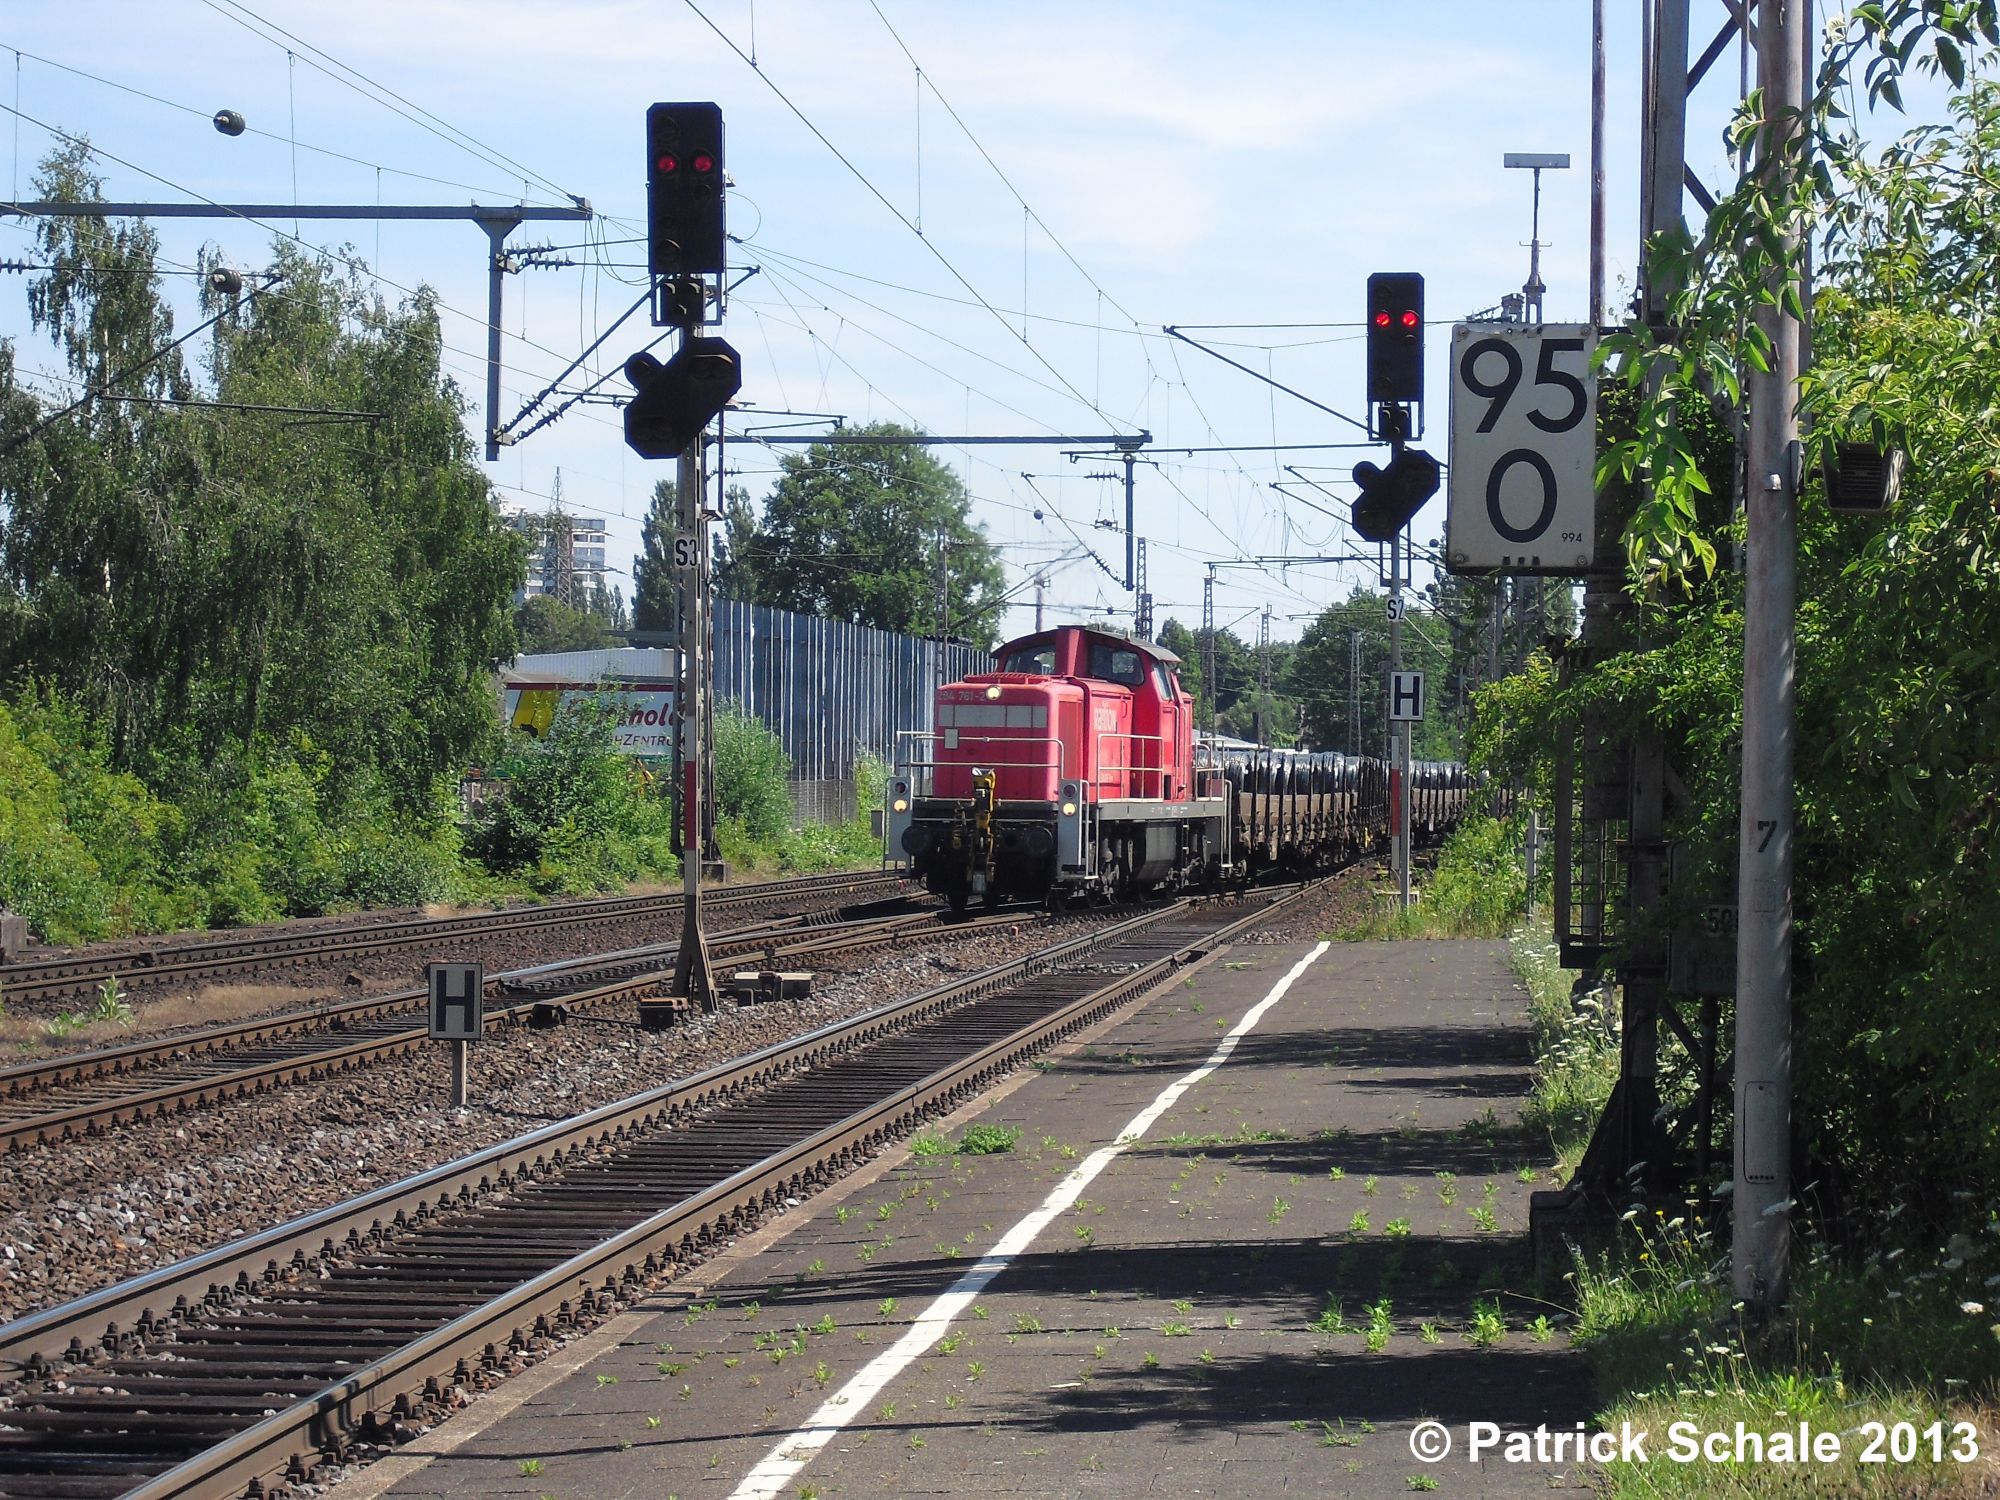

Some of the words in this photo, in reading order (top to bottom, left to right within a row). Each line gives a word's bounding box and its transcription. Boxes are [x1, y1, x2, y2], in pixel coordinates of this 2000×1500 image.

[1460, 338, 1588, 434] 95
[1486, 448, 1557, 543] 0
[675, 539, 697, 566] S3
[1561, 532, 1582, 543] 994
[1394, 675, 1420, 716] H
[1757, 820, 1777, 853] 7
[436, 970, 475, 1032] H
